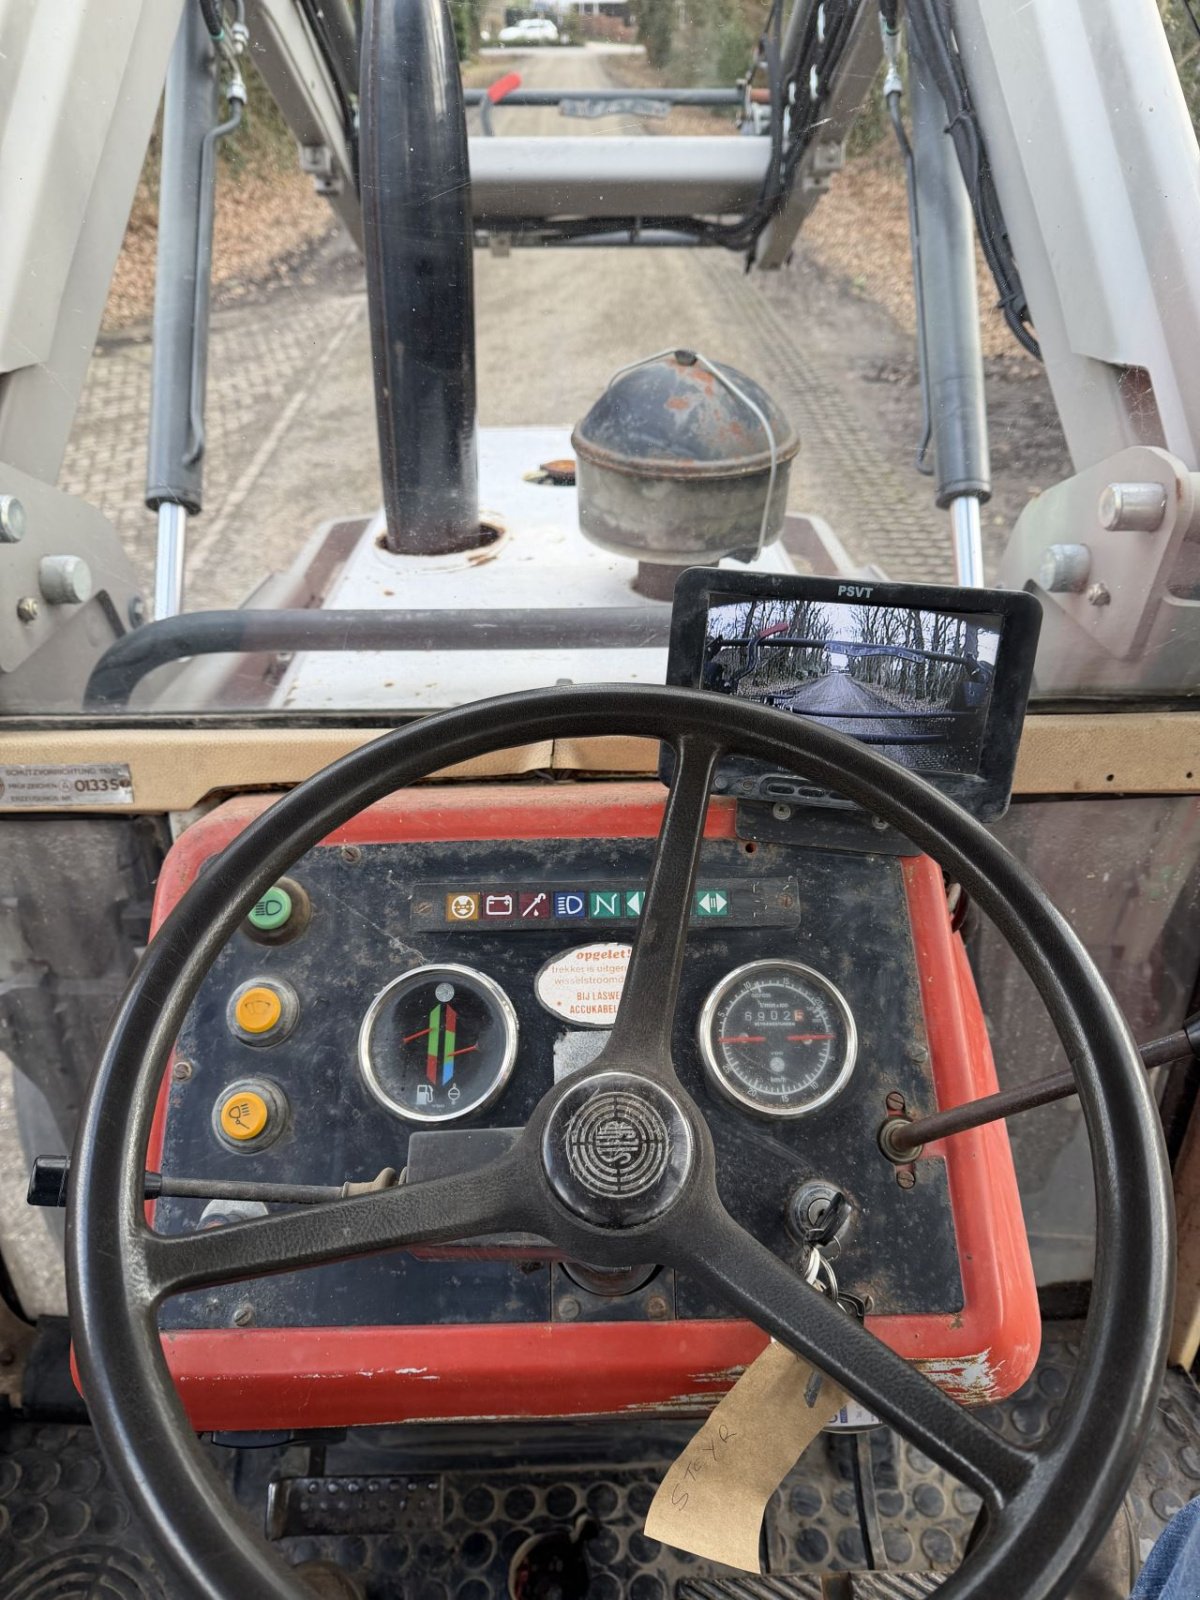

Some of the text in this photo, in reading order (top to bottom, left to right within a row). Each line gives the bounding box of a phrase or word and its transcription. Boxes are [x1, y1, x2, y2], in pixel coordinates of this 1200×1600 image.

[837, 585, 874, 598] PSVT
[74, 779, 109, 792] 0133
[576, 949, 631, 961] opgelet!
[576, 991, 590, 1001] BIJ
[671, 1424, 737, 1512] STEYR
